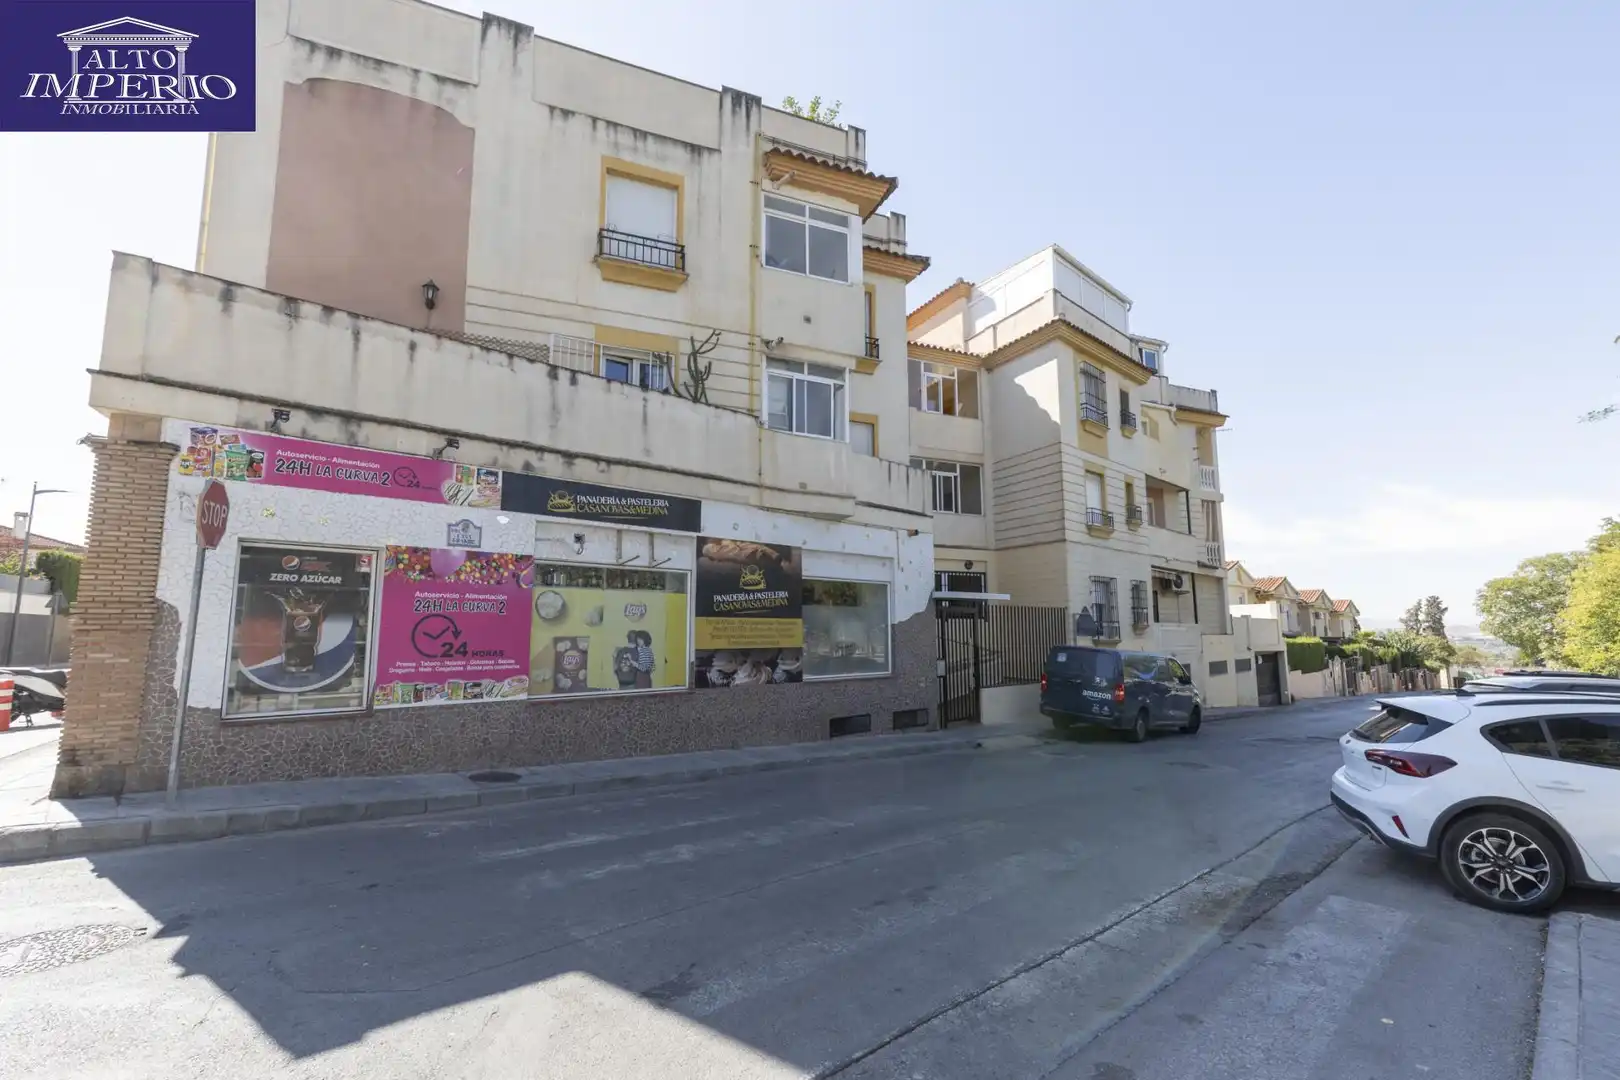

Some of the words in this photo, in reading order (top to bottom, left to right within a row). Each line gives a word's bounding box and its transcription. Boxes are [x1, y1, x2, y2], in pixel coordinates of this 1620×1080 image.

[276, 449, 326, 461] Autoservicio
[332, 456, 380, 469] Alimentación
[275, 457, 312, 476] 24H
[316, 463, 332, 478] LA
[335, 467, 379, 484] CURVA
[380, 471, 391, 487] 2
[202, 500, 227, 528] STOP
[269, 573, 298, 582] ZERO
[300, 572, 342, 584] AZÚCAR
[414, 590, 460, 599] Autoservicio
[464, 592, 508, 600] Alimentación
[414, 598, 443, 613] 24H
[445, 601, 458, 612] LA
[462, 601, 497, 613] CURVA
[498, 600, 507, 615] 2
[440, 641, 468, 658] 24
[472, 649, 504, 658] HORAS
[1082, 689, 1111, 700] amazon
